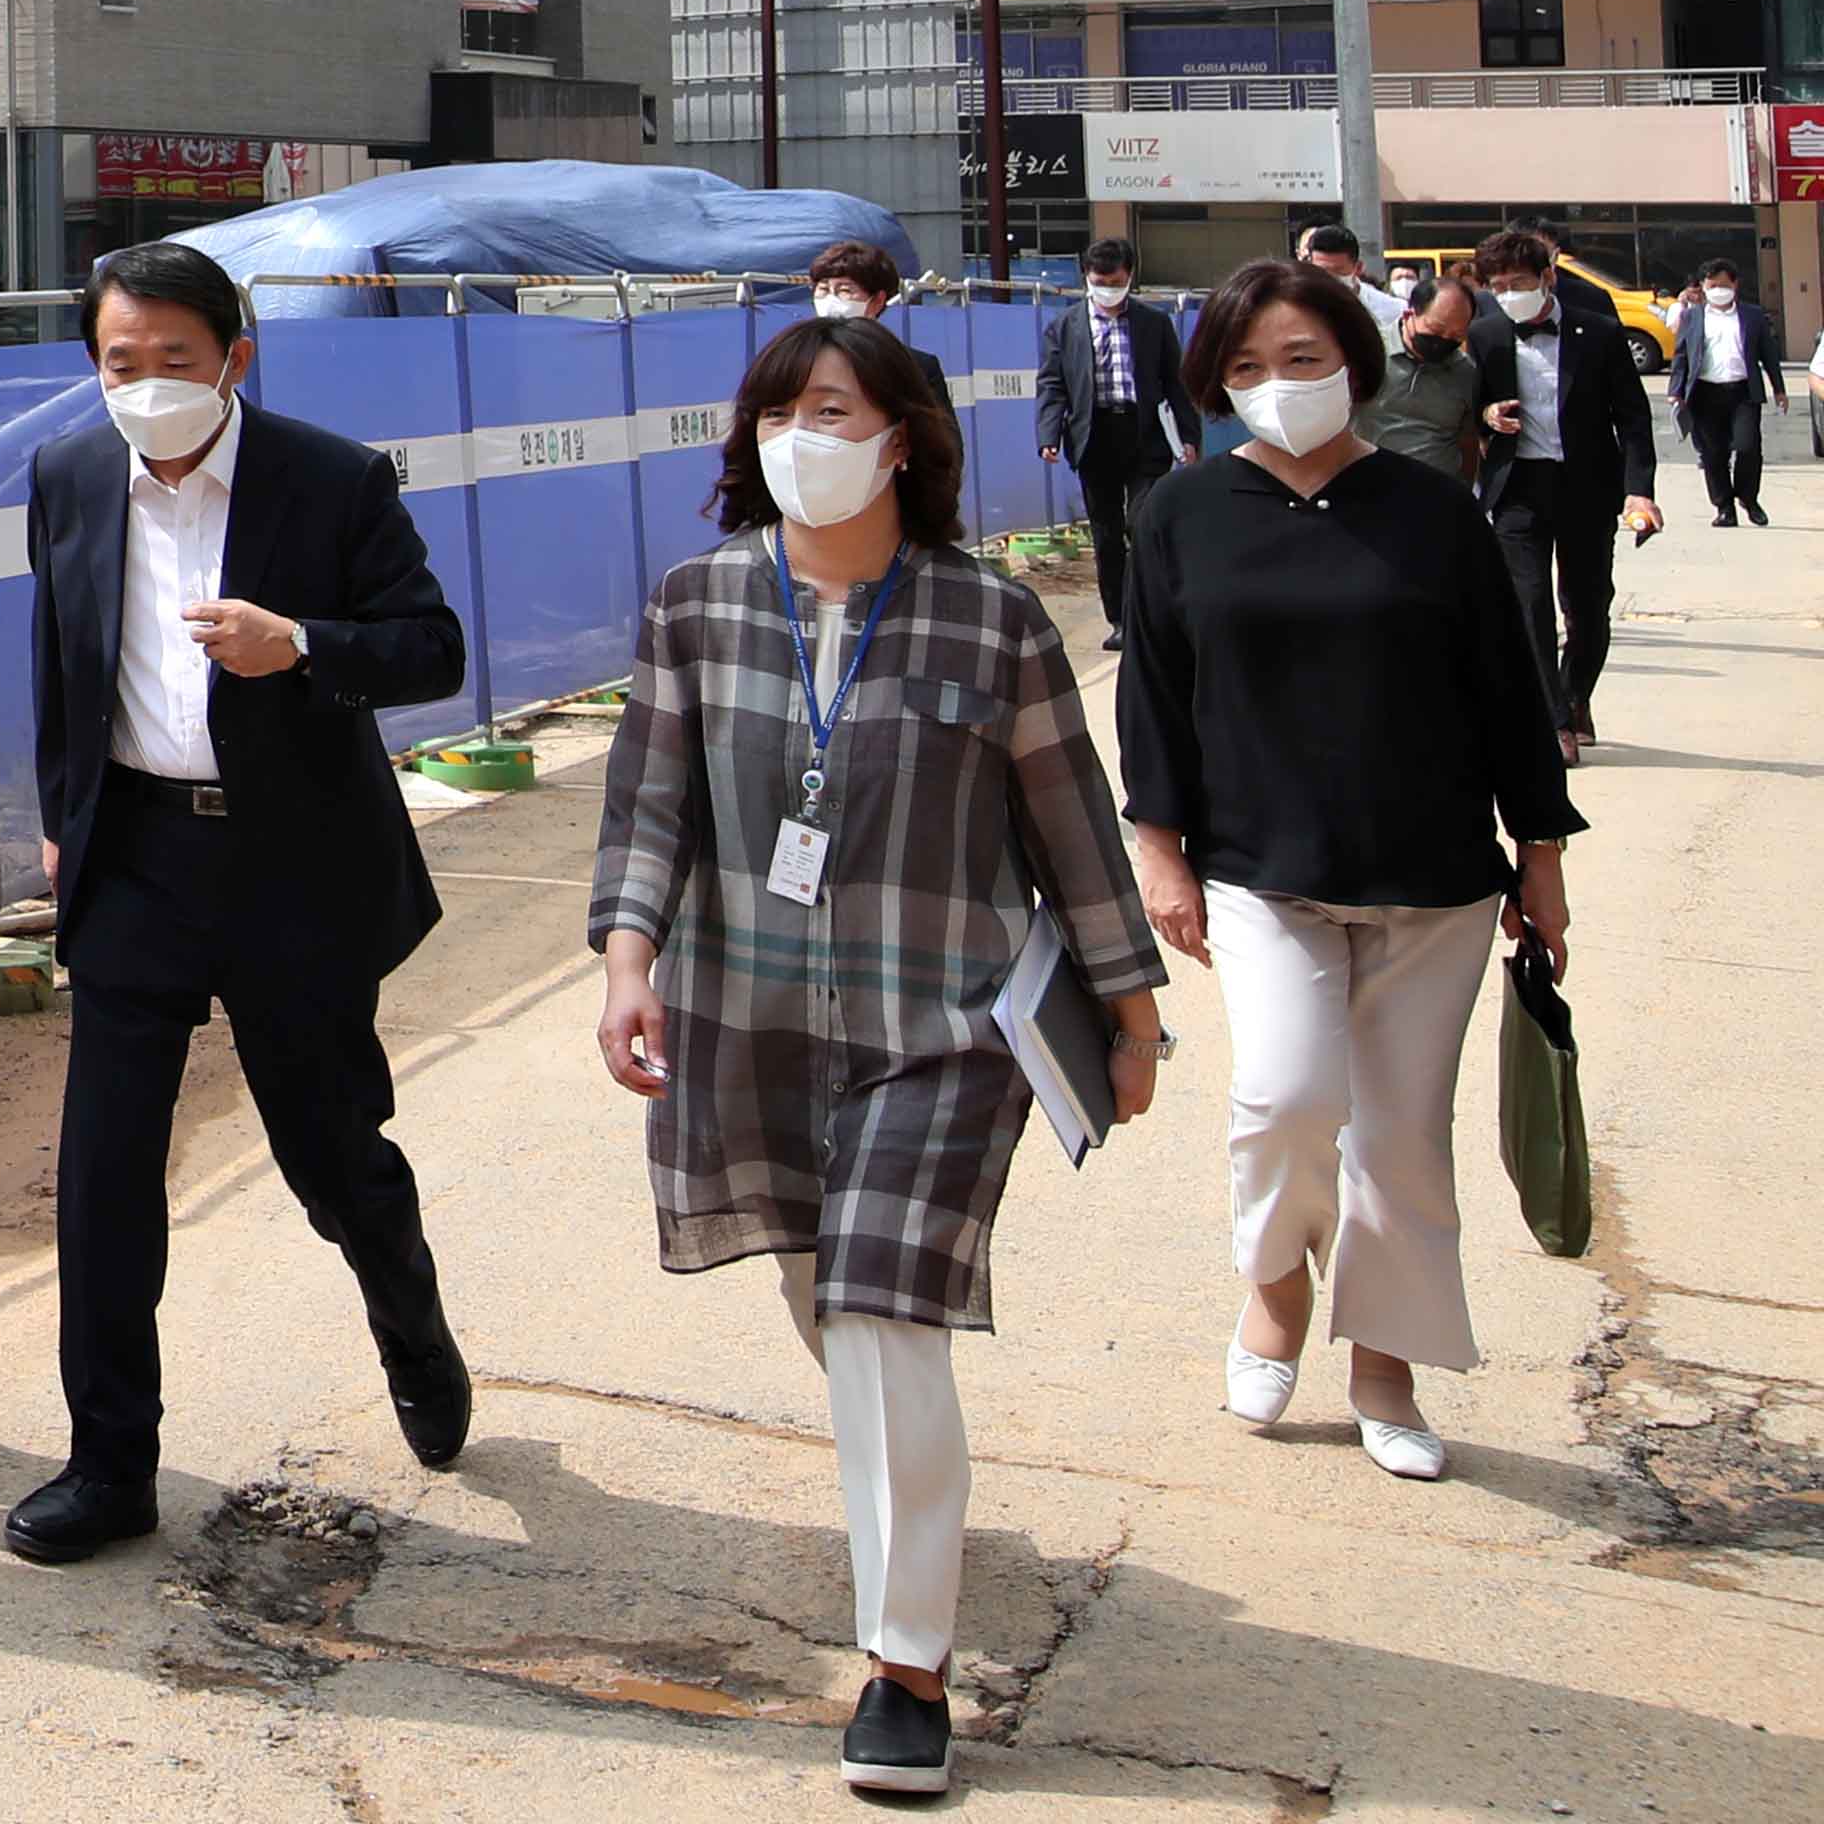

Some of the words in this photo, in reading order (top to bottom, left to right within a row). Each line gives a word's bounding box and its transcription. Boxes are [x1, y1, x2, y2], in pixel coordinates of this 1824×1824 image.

[1182, 63, 1227, 74] GLORIA
[1229, 62, 1268, 74] PIANO
[1106, 137, 1160, 156] VIITZ
[1104, 175, 1155, 188] EAGON
[1791, 174, 1824, 198] 7
[520, 431, 546, 465] 안전
[560, 426, 585, 462] 제일
[385, 446, 409, 486] 일
